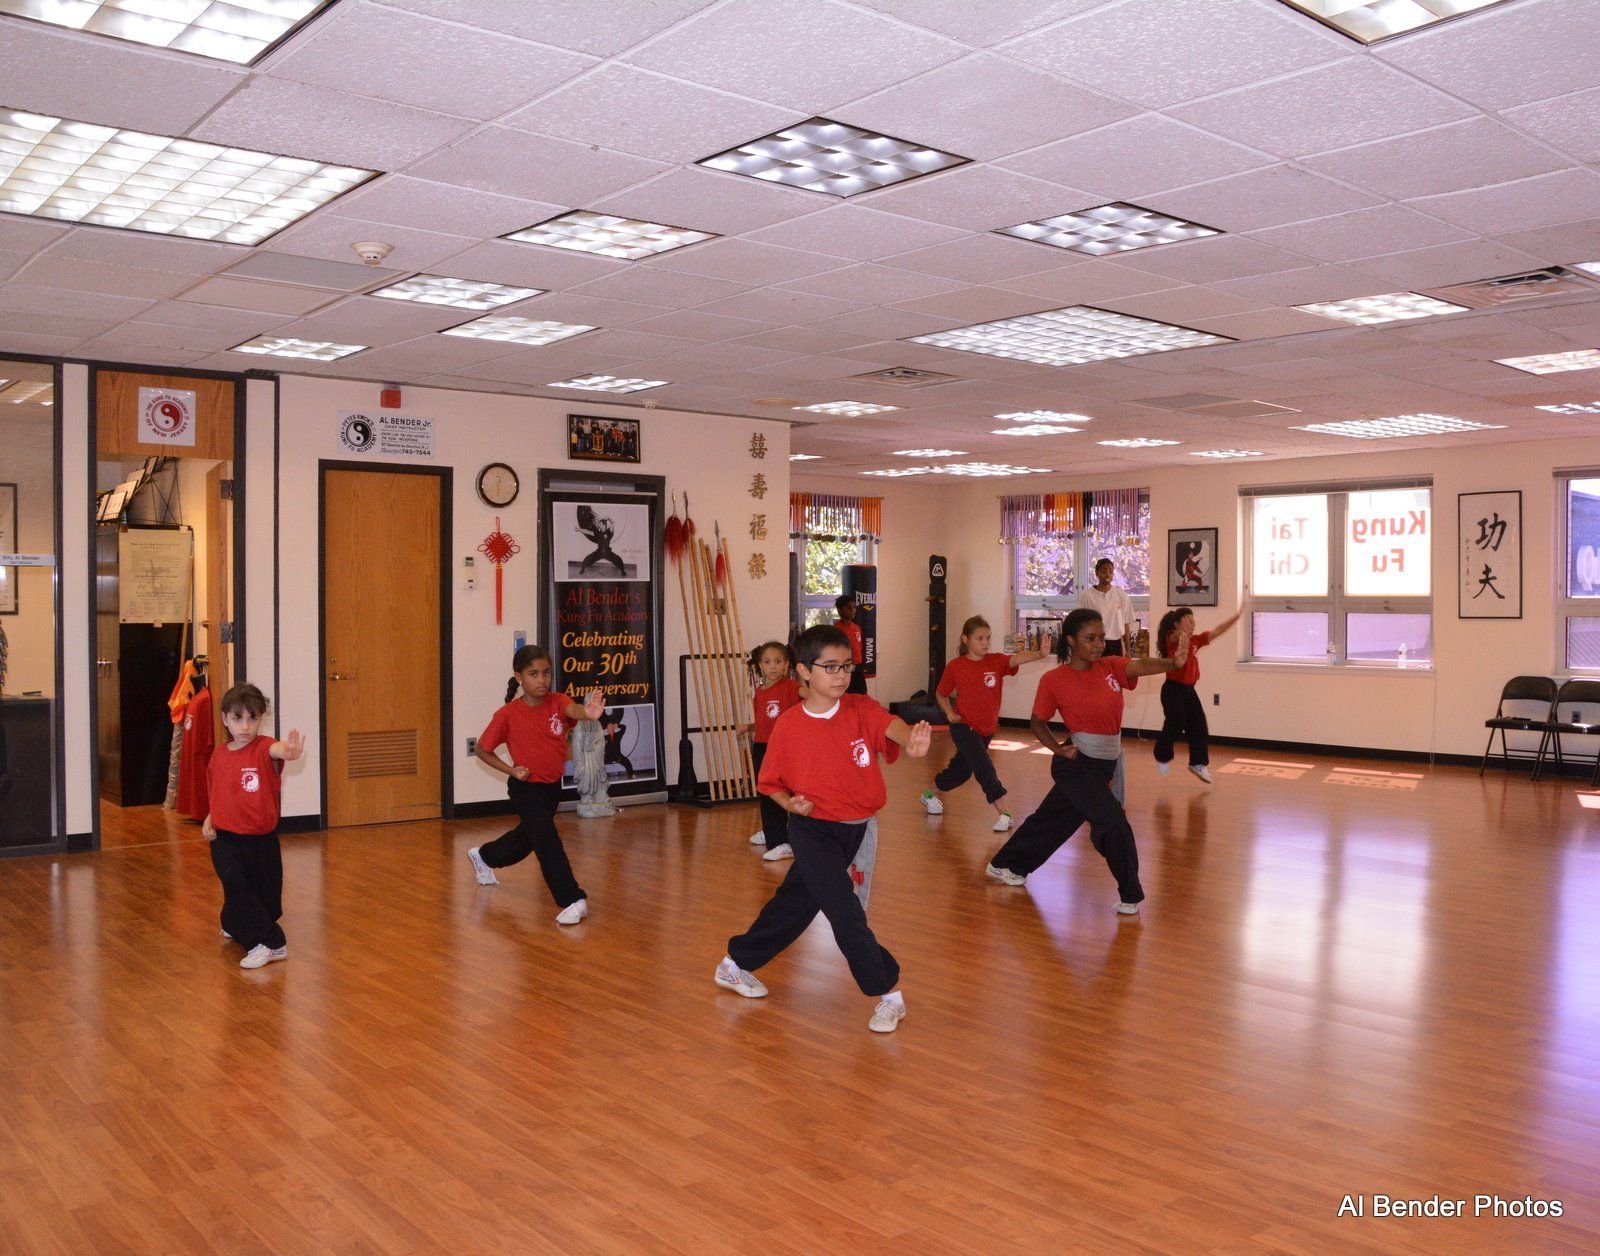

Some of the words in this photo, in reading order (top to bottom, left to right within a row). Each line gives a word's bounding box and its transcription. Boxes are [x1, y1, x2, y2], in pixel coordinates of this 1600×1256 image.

[379, 416, 389, 424] AL
[390, 417, 422, 427] BENDER
[356, 433, 377, 452] ACADEMY
[1472, 512, 1507, 600] 功夫
[566, 587, 582, 606] Al
[586, 587, 641, 606] Bender's
[557, 610, 586, 626] Kung
[589, 610, 602, 623] Fu
[605, 607, 650, 624] Academy
[562, 630, 645, 650] Celebrating
[865, 637, 874, 664] MMA
[563, 656, 594, 673] Our
[597, 650, 638, 676] 30th
